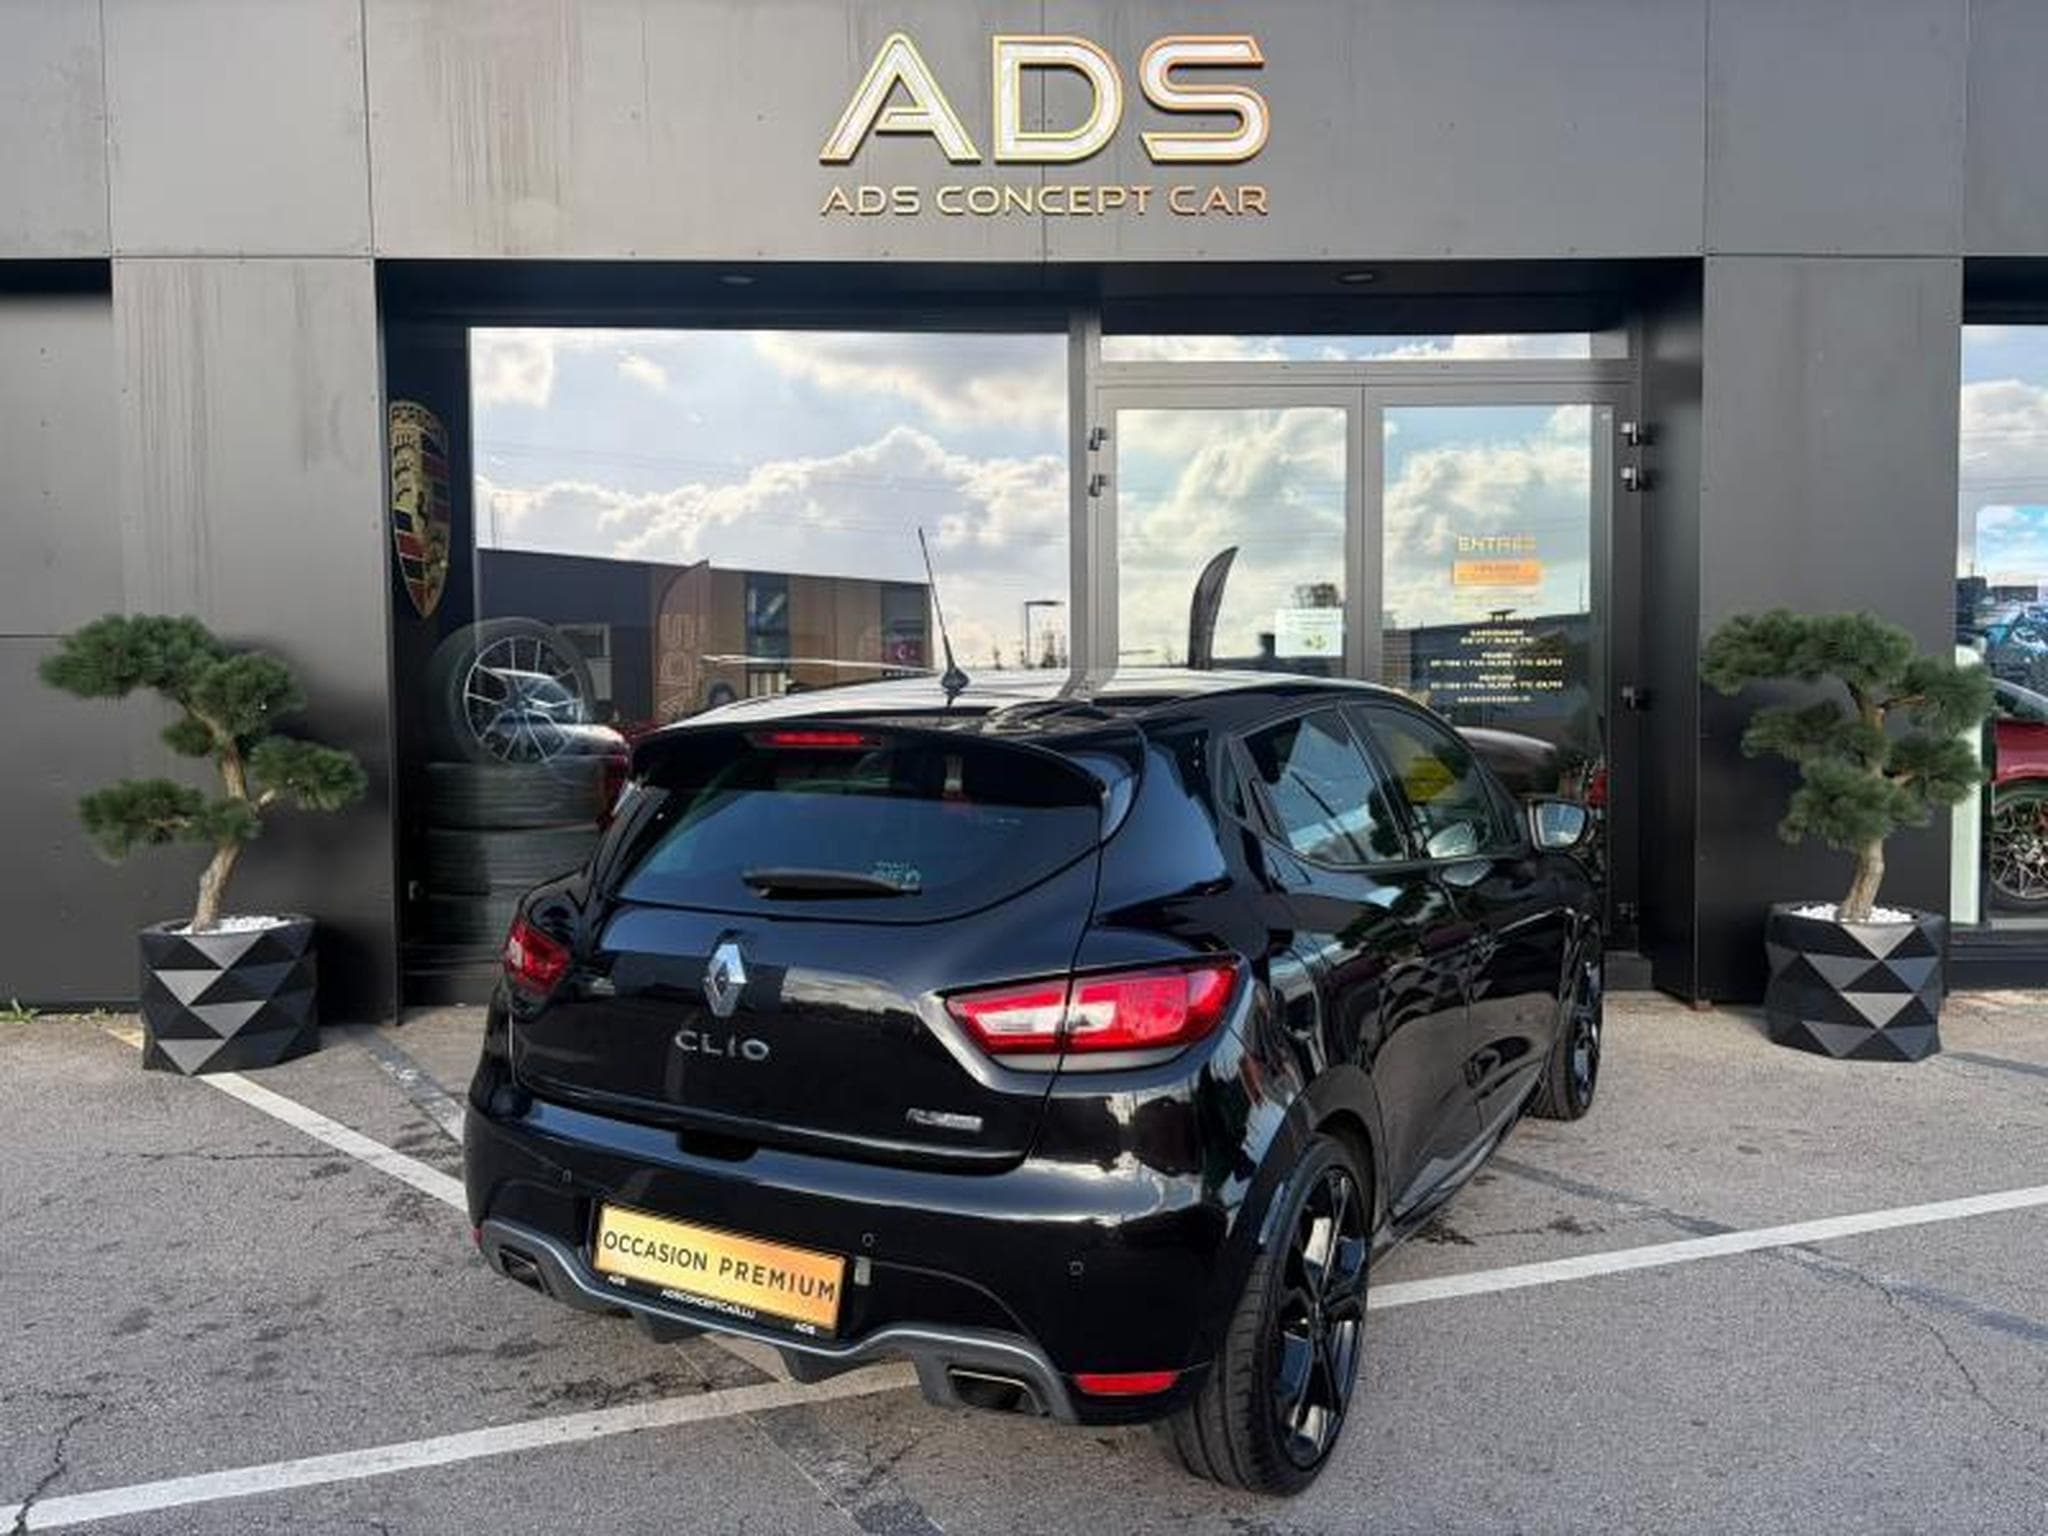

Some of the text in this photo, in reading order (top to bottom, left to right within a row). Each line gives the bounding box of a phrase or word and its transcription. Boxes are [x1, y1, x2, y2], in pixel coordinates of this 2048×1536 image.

[819, 32, 1271, 164] ADS
[820, 185, 1270, 216] ADS CONCEPT CAR
[675, 1029, 770, 1061] CLIO
[602, 1230, 836, 1302] OCCASION PREMIUM
